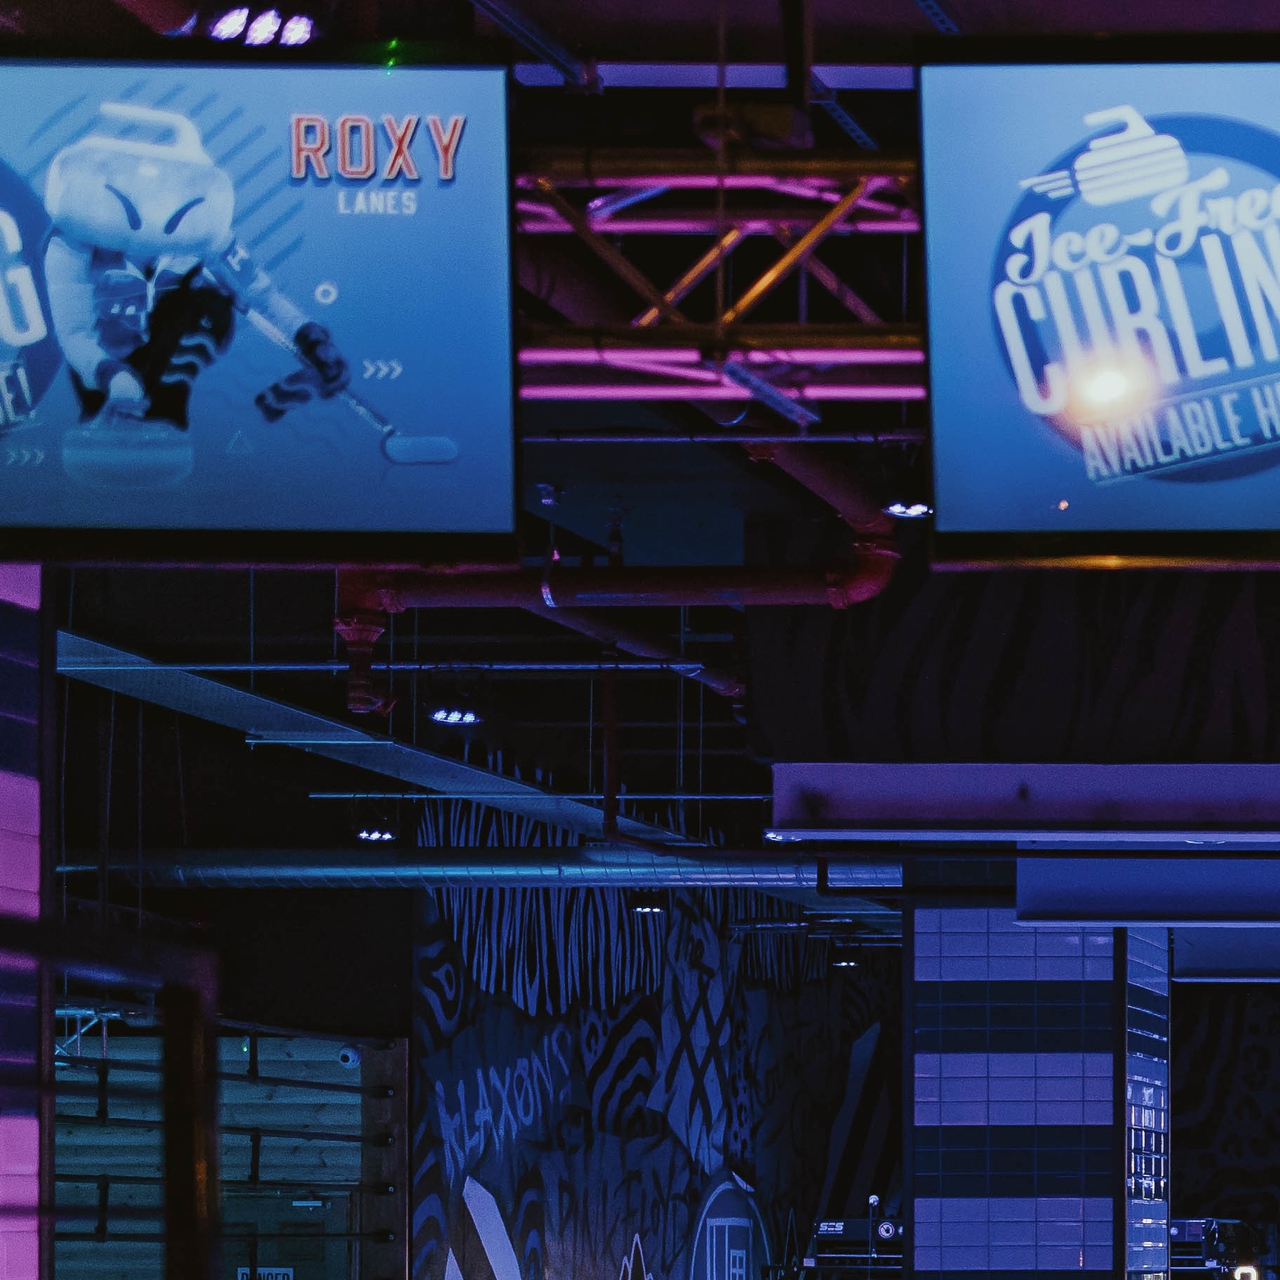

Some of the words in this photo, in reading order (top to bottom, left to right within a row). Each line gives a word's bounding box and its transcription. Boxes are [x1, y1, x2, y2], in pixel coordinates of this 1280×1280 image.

[291, 113, 466, 181] ROXY
[338, 191, 418, 215] LANES
[1081, 392, 1252, 481] AVAILABLE
